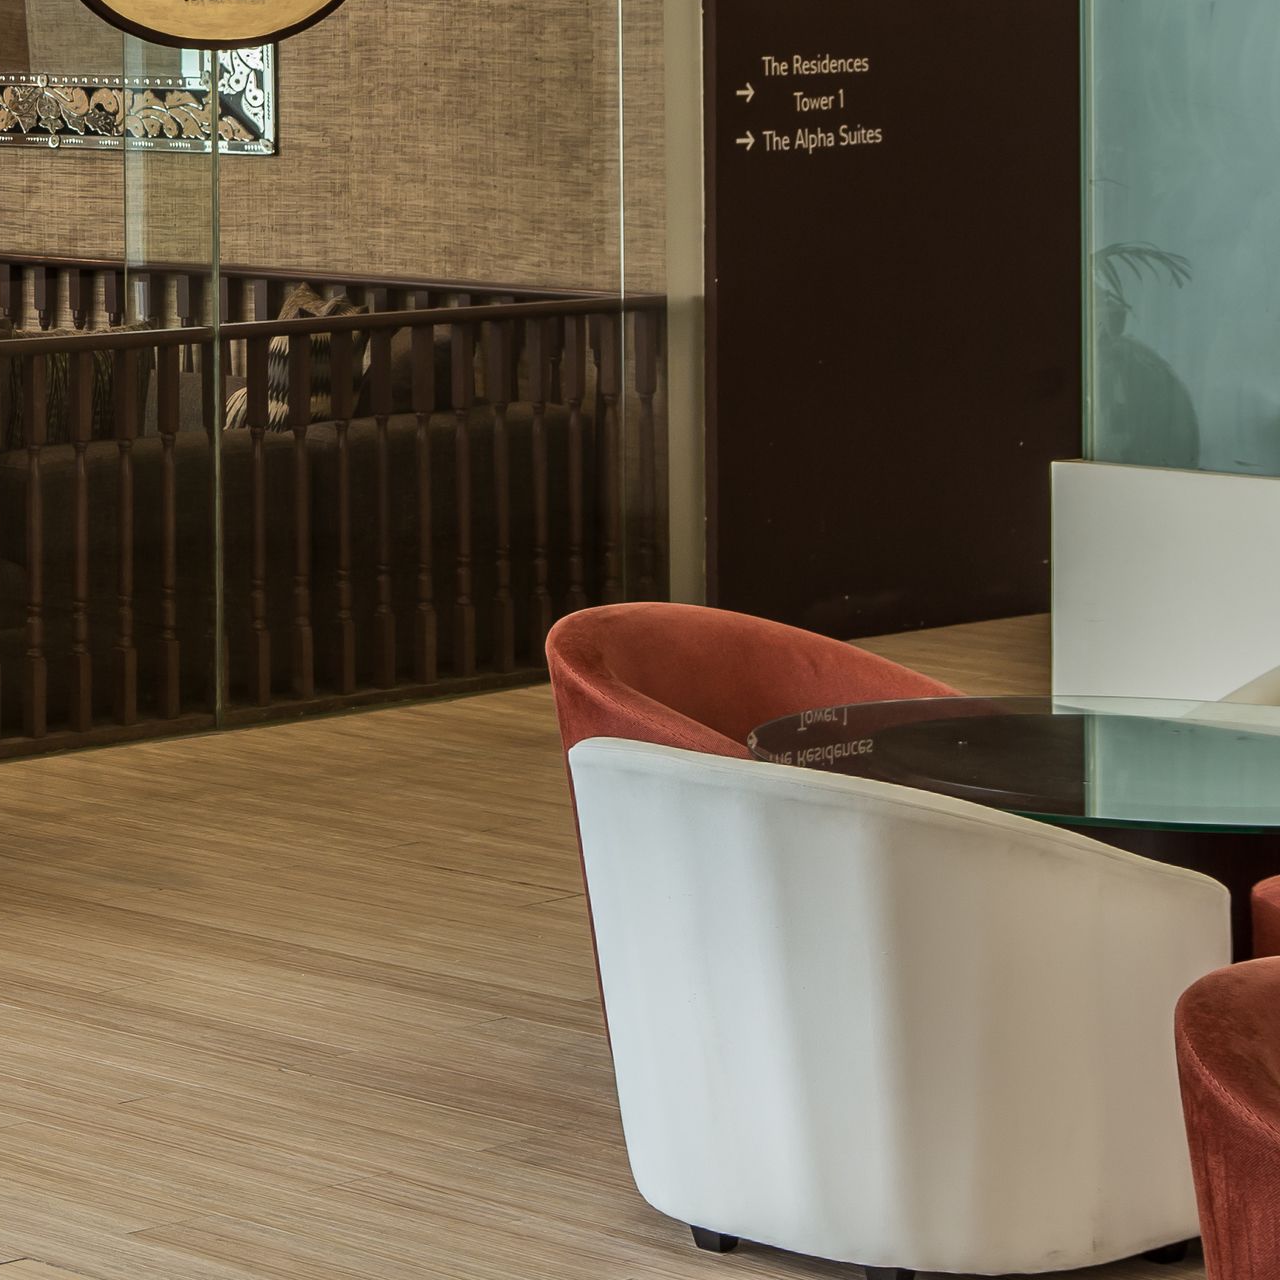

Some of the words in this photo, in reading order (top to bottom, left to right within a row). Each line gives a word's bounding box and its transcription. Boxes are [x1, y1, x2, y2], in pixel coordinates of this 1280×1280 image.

[762, 56, 788, 76] The
[792, 53, 870, 75] Residences
[792, 91, 836, 112] Tower
[838, 89, 844, 109] 1
[761, 130, 791, 152] The
[793, 127, 836, 155] Alpha
[839, 123, 883, 147] Suites
